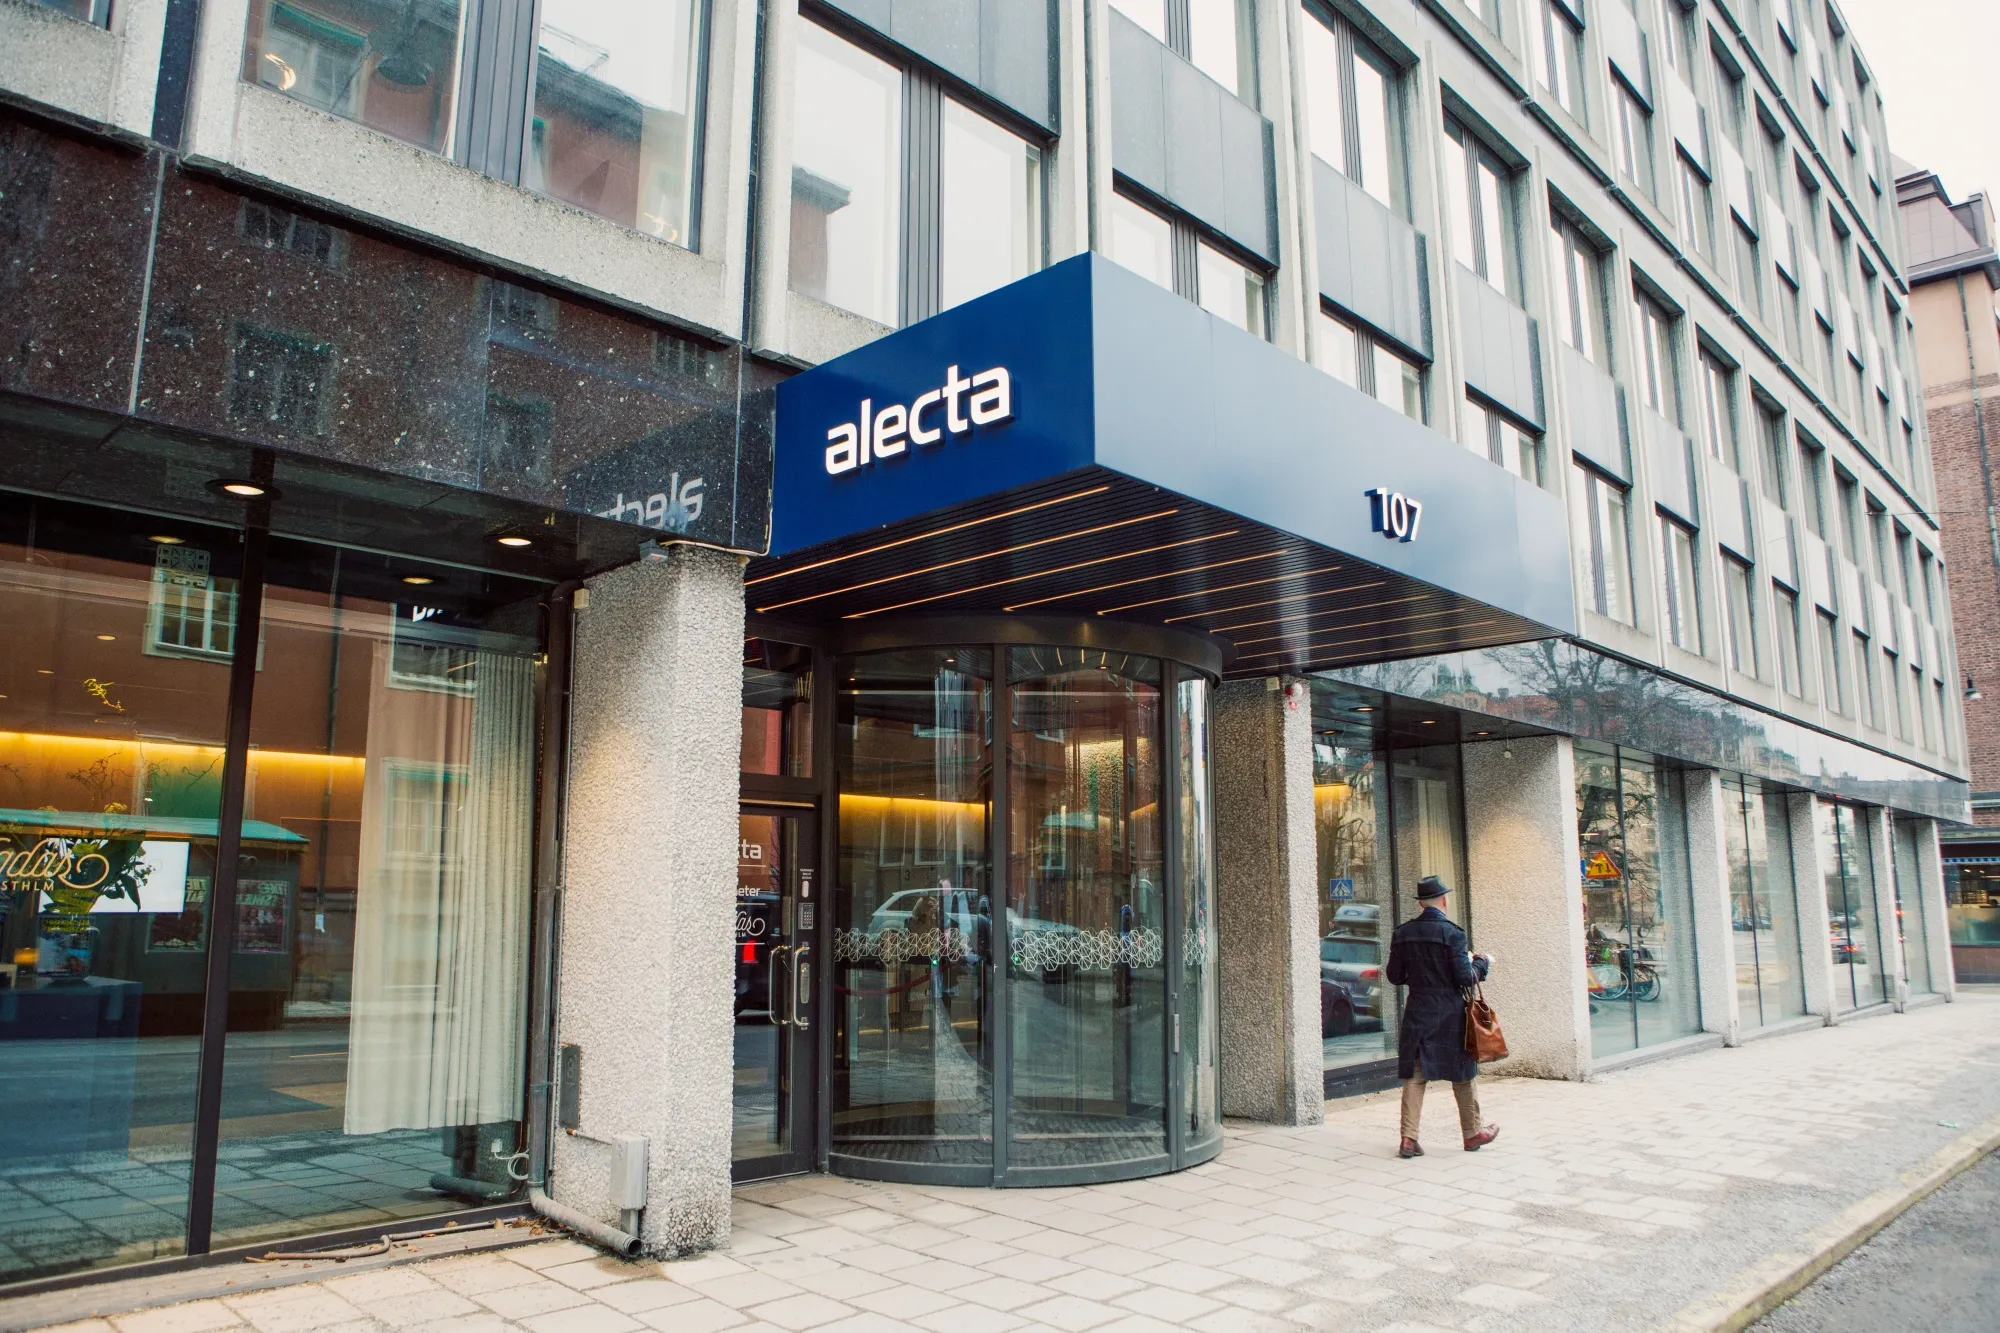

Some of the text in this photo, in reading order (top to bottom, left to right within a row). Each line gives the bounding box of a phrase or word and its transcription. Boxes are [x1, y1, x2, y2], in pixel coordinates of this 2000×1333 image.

[826, 365, 1012, 475] alecta
[1366, 486, 1422, 542] 107
[1, 880, 54, 890] STHLM
